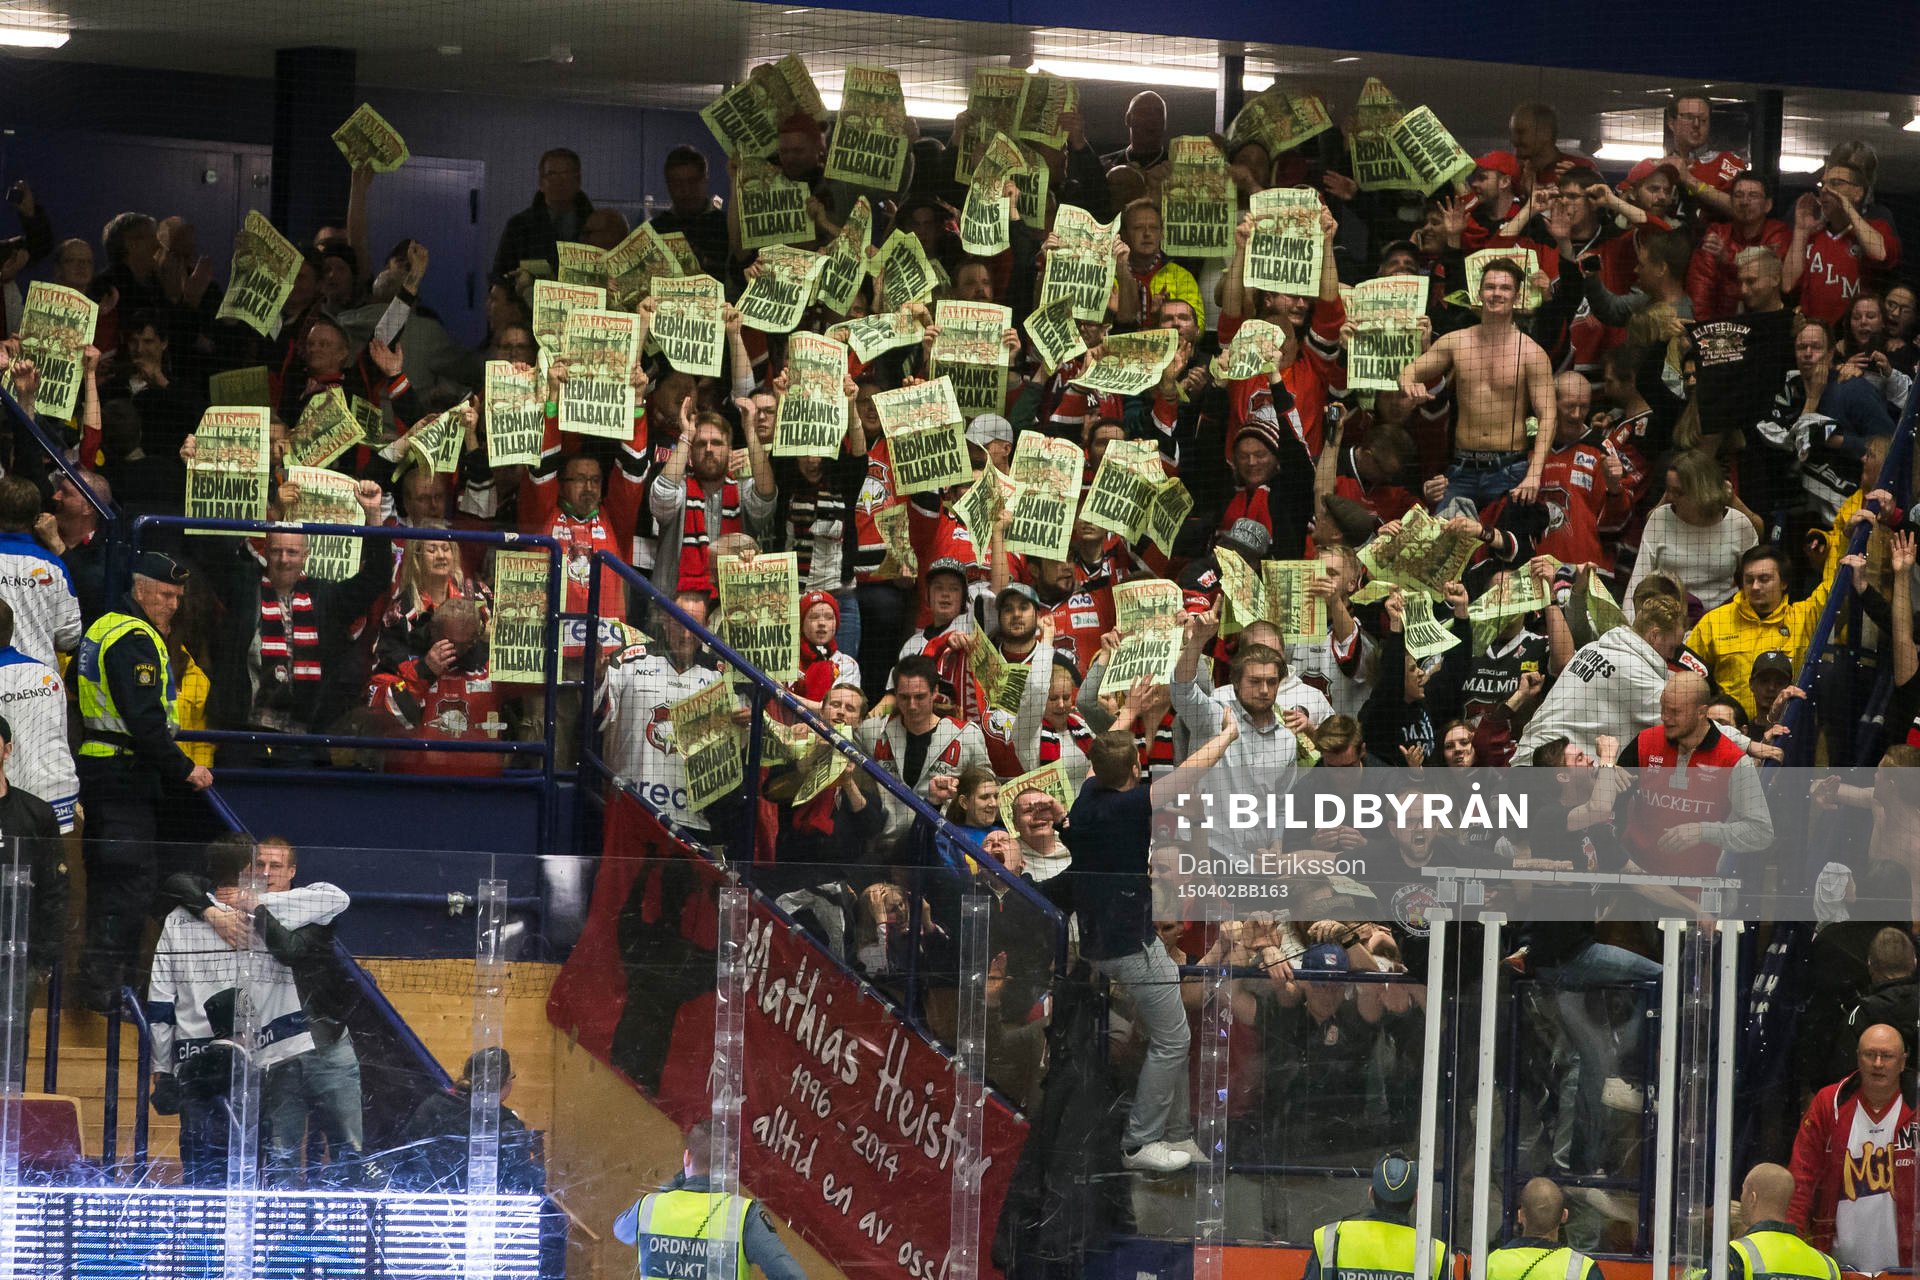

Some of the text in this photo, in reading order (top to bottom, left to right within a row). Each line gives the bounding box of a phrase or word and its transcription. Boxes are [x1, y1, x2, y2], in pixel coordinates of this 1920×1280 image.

[839, 127, 900, 157] REDHAWKS
[1394, 128, 1440, 182] TILLBAKA!
[1407, 114, 1459, 171] REDHAWKS
[833, 150, 895, 181] TILLBAKA!
[743, 187, 804, 214] REDHAWKS
[1166, 202, 1229, 224] REDHAWKS
[744, 210, 806, 238] TILLBAKA!
[1166, 224, 1228, 247] TILLBAKA!
[1251, 233, 1314, 259] REDHAWKS
[1050, 261, 1108, 286] REDHAWKS
[1250, 256, 1312, 285] TILLBAKA!
[750, 279, 803, 302] REDHAWKS
[739, 298, 795, 327] TILLBAKA!
[654, 315, 716, 344] REDHAWKS
[1692, 322, 1751, 339] ELITSERIEN
[1353, 335, 1414, 356] REDHAWKS
[565, 378, 626, 405] REDHAWKS
[564, 401, 626, 428] TILLBAKA!
[781, 400, 840, 425] REDHAWKS
[779, 423, 840, 448] TILLBAKA!
[894, 429, 958, 464] REDHAWKS
[897, 452, 962, 485] TILLBAKA!
[191, 476, 259, 501] REDHAWKS
[190, 501, 259, 520] TILLBAKA!
[309, 536, 353, 558] HAWKS
[308, 560, 351, 580] BAKA!
[728, 623, 792, 650] REDHAWKS
[1113, 641, 1171, 666] REDHAWKS
[1107, 662, 1167, 685] TILLBAKA!
[1462, 677, 1519, 693] MALMÖ
[687, 736, 737, 781] REDHAWKS
[690, 758, 739, 802] TILLBAKA!
[738, 917, 859, 1086] Mathias
[790, 1063, 832, 1119] 1996
[851, 1124, 899, 1182] 2014
[752, 1104, 820, 1181] alltid
[822, 1173, 853, 1215] en
[858, 1211, 894, 1245] av
[665, 1260, 705, 1277] VAKT
